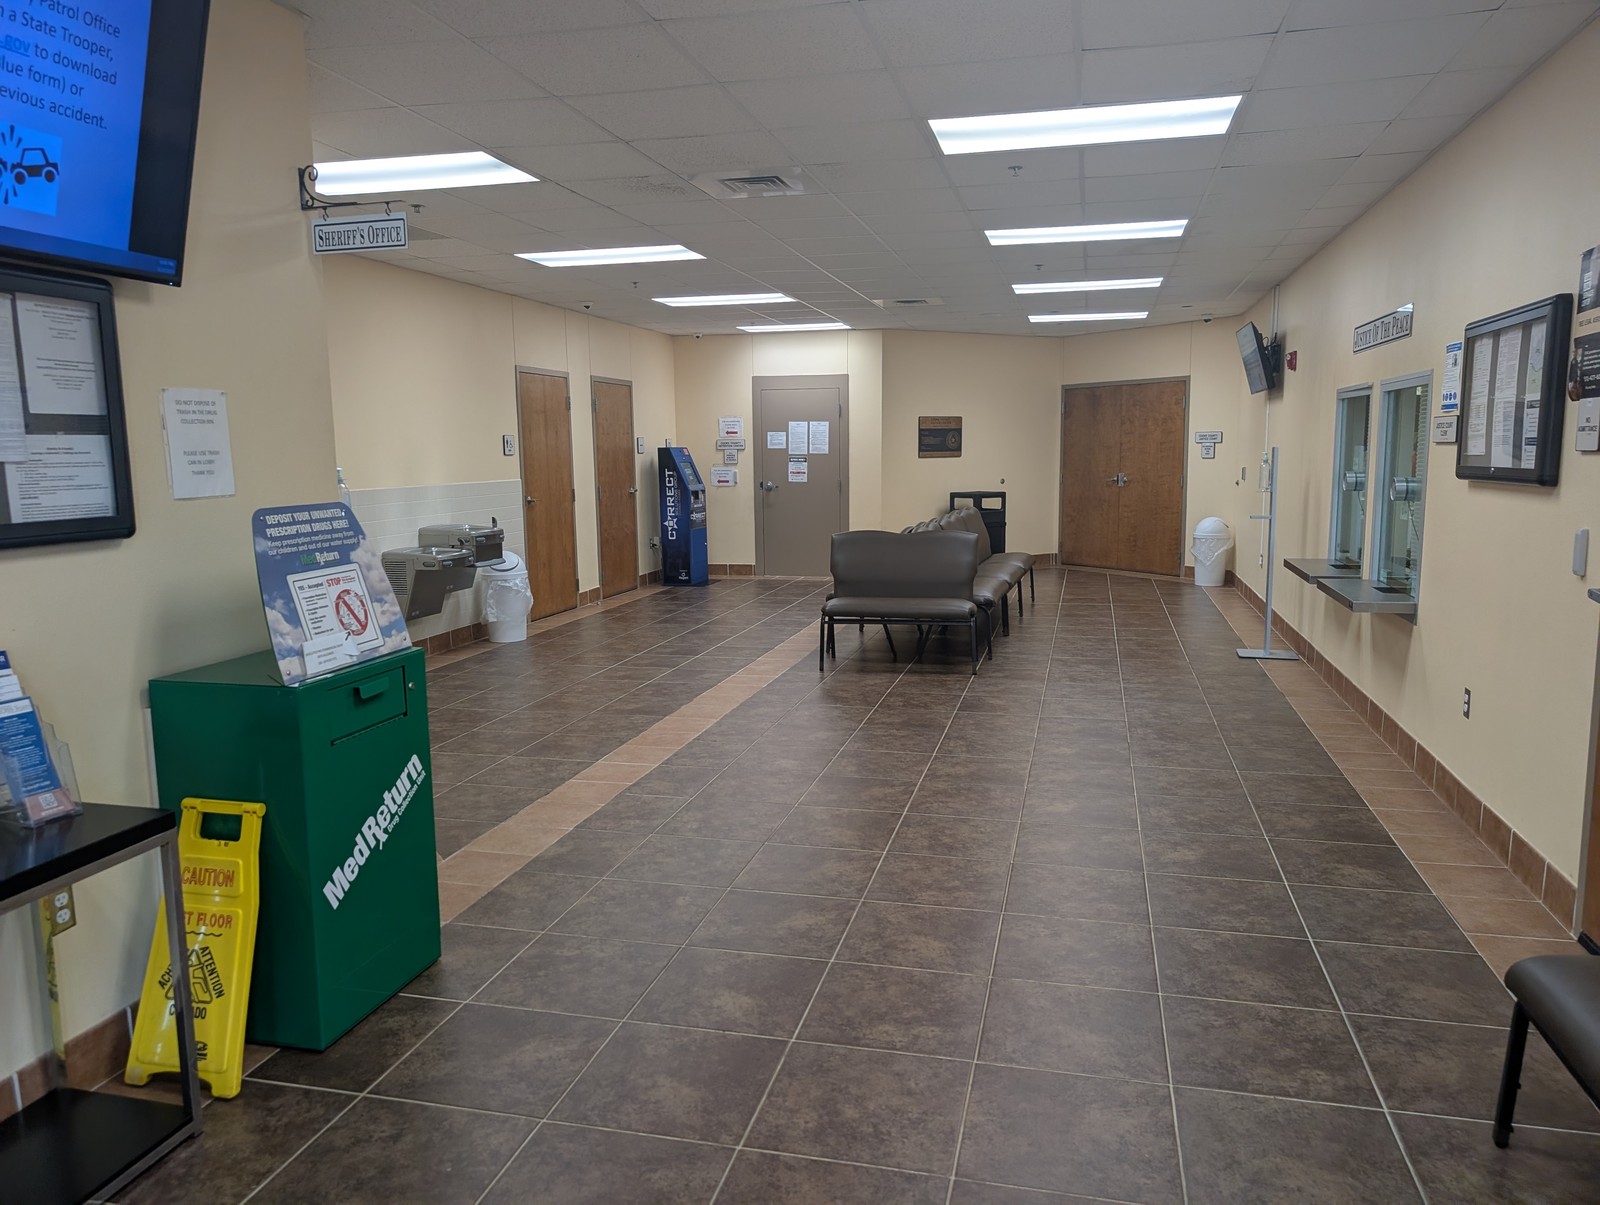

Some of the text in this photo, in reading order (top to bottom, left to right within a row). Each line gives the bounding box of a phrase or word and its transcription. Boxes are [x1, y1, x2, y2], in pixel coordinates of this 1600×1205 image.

[9, 10, 17, 22] a
[21, 11, 57, 38] State
[61, 26, 114, 62] Trooper,
[83, 11, 121, 39] Office
[34, 43, 49, 60] to
[53, 51, 118, 85] download
[28, 65, 66, 94] form)
[70, 83, 85, 97] or
[49, 101, 108, 130] accident.
[317, 225, 402, 247] SHERIFF'S OFFICE
[1354, 314, 1410, 349] JUSTICE OF THE PEACE
[265, 508, 342, 525] DEPOSIT YOUR UNWANTED
[265, 519, 350, 538] PRESCRIPTION DRUGS HERE!
[267, 540, 282, 549] Keep
[282, 536, 312, 546] prescription
[311, 533, 332, 541] medicine
[278, 546, 298, 555] children
[326, 577, 341, 587] STOP
[386, 769, 427, 833] Drug Collection Unit
[322, 754, 423, 911] MedReturn
[182, 866, 235, 888] CAUTION
[196, 911, 233, 929] FLOOR
[199, 945, 226, 999] ATTENTION
